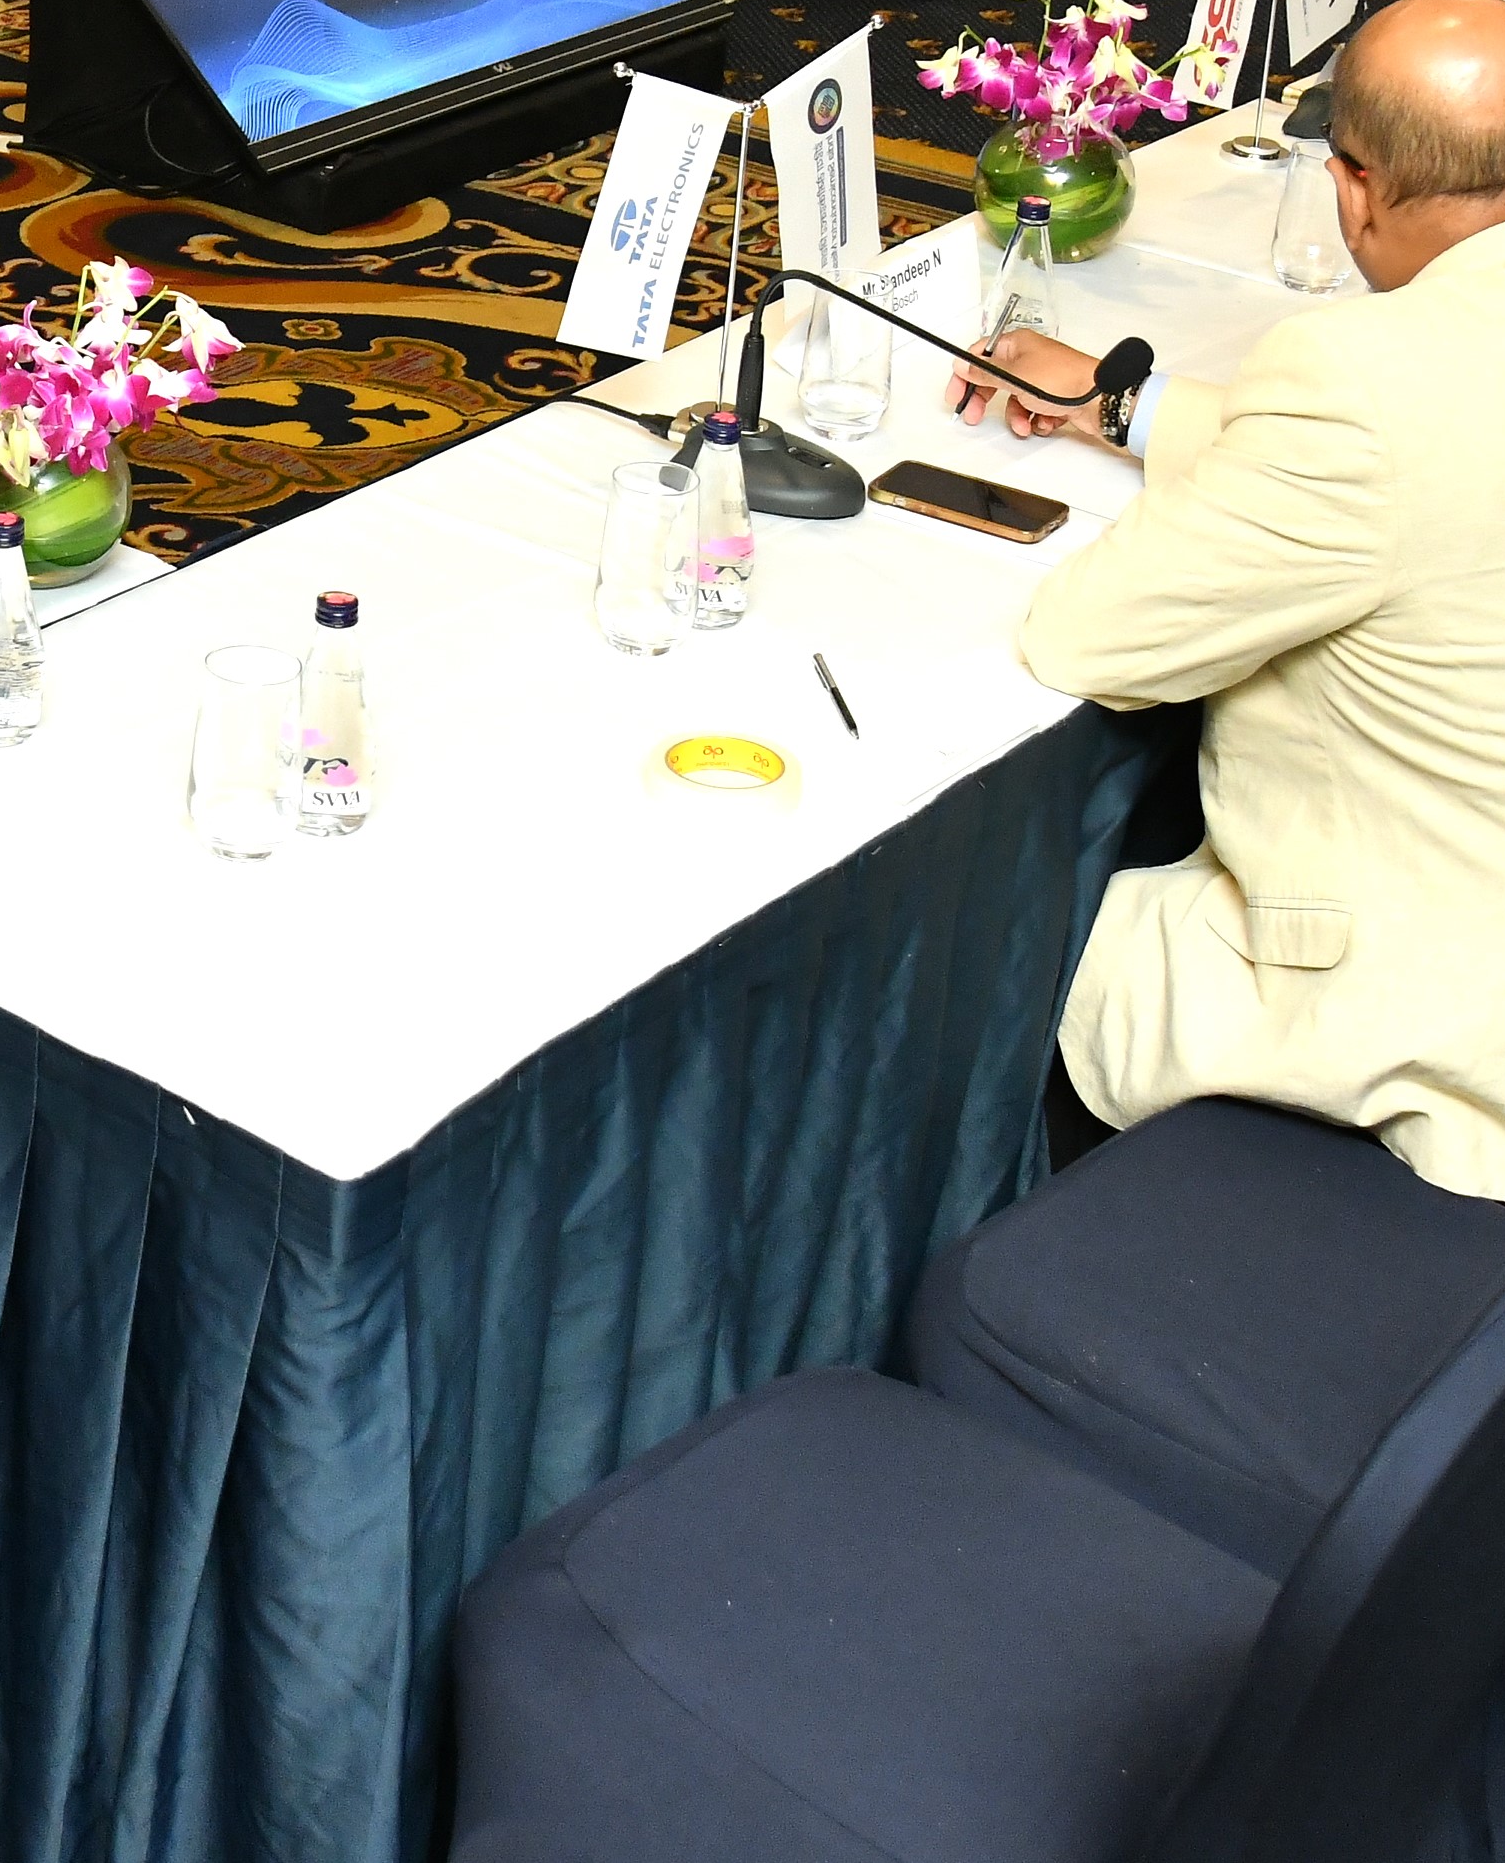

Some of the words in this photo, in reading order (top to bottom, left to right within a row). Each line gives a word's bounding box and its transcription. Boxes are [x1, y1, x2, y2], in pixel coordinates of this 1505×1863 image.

[650, 122, 704, 270] ELECTRONICS
[629, 197, 658, 265] TATA
[862, 282, 878, 296] Mr.
[880, 259, 931, 290] Sandeep
[893, 289, 919, 312] Bosch
[632, 278, 657, 348] TATA
